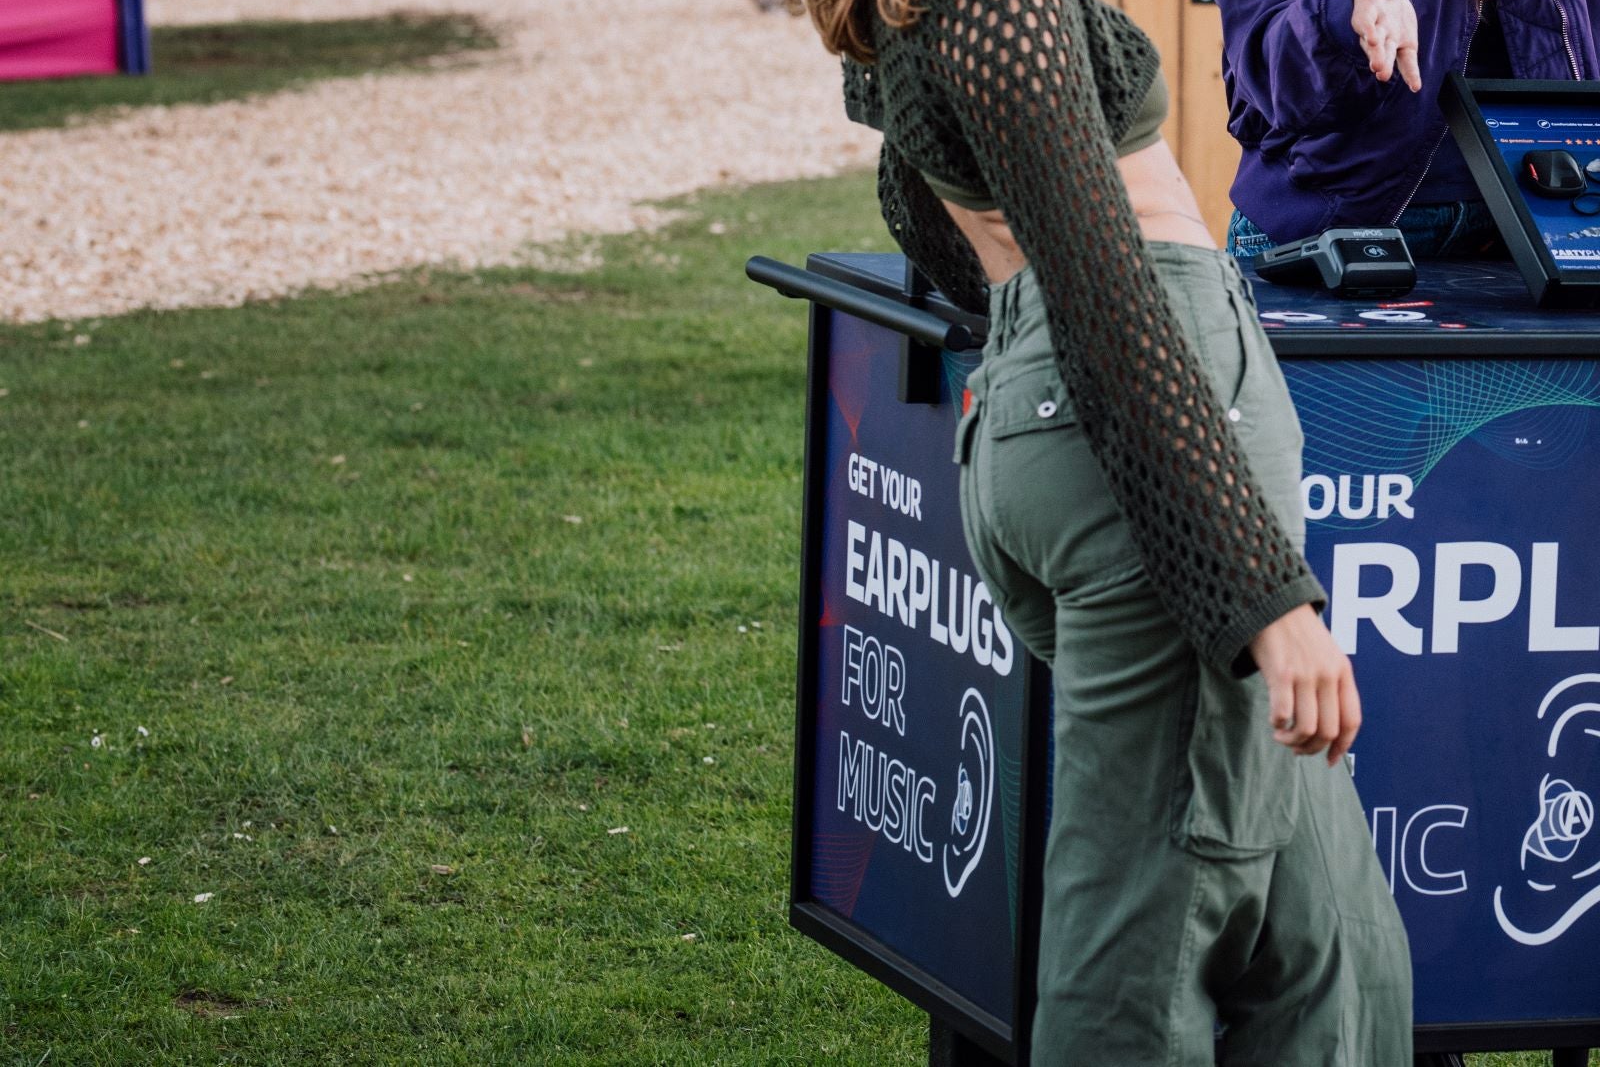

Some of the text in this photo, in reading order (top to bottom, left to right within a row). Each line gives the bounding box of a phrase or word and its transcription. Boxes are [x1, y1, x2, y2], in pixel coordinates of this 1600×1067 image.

[848, 452, 922, 521] GET YOUR
[1300, 474, 1415, 520] OUR
[846, 519, 1014, 677] EARPLUGS
[842, 624, 906, 737] FOR
[837, 731, 936, 863] MUSIC
